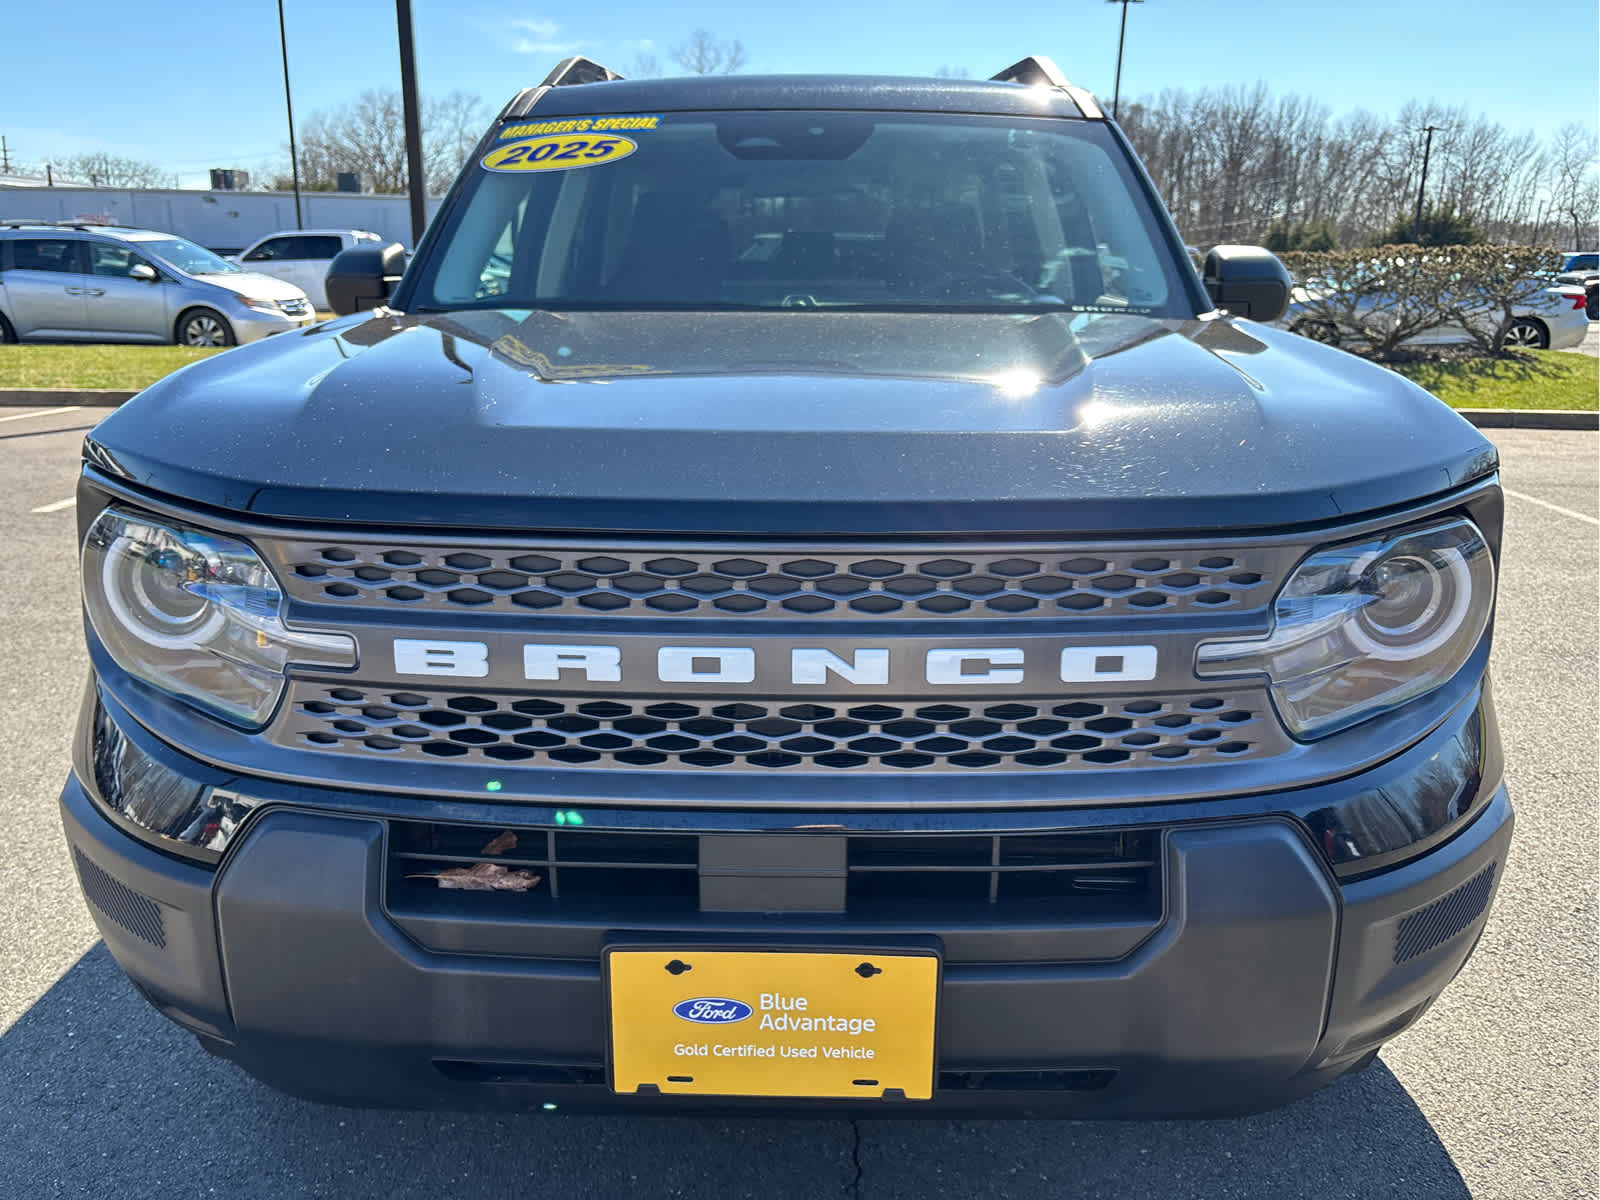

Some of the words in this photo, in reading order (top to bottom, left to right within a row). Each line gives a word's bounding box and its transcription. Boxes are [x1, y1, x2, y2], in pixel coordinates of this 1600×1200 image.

[500, 119, 592, 138] MANAGER'S
[592, 117, 658, 130] SPECIAL
[495, 140, 621, 166] 2025
[393, 638, 1158, 685] BRONCO
[688, 1000, 737, 1020] Ford
[759, 993, 808, 1011] Blue
[759, 1013, 876, 1035] Advantage
[673, 1043, 708, 1057] Gold
[712, 1044, 775, 1058] Certified
[780, 1046, 817, 1059] Used
[822, 1046, 875, 1060] Vehicle
